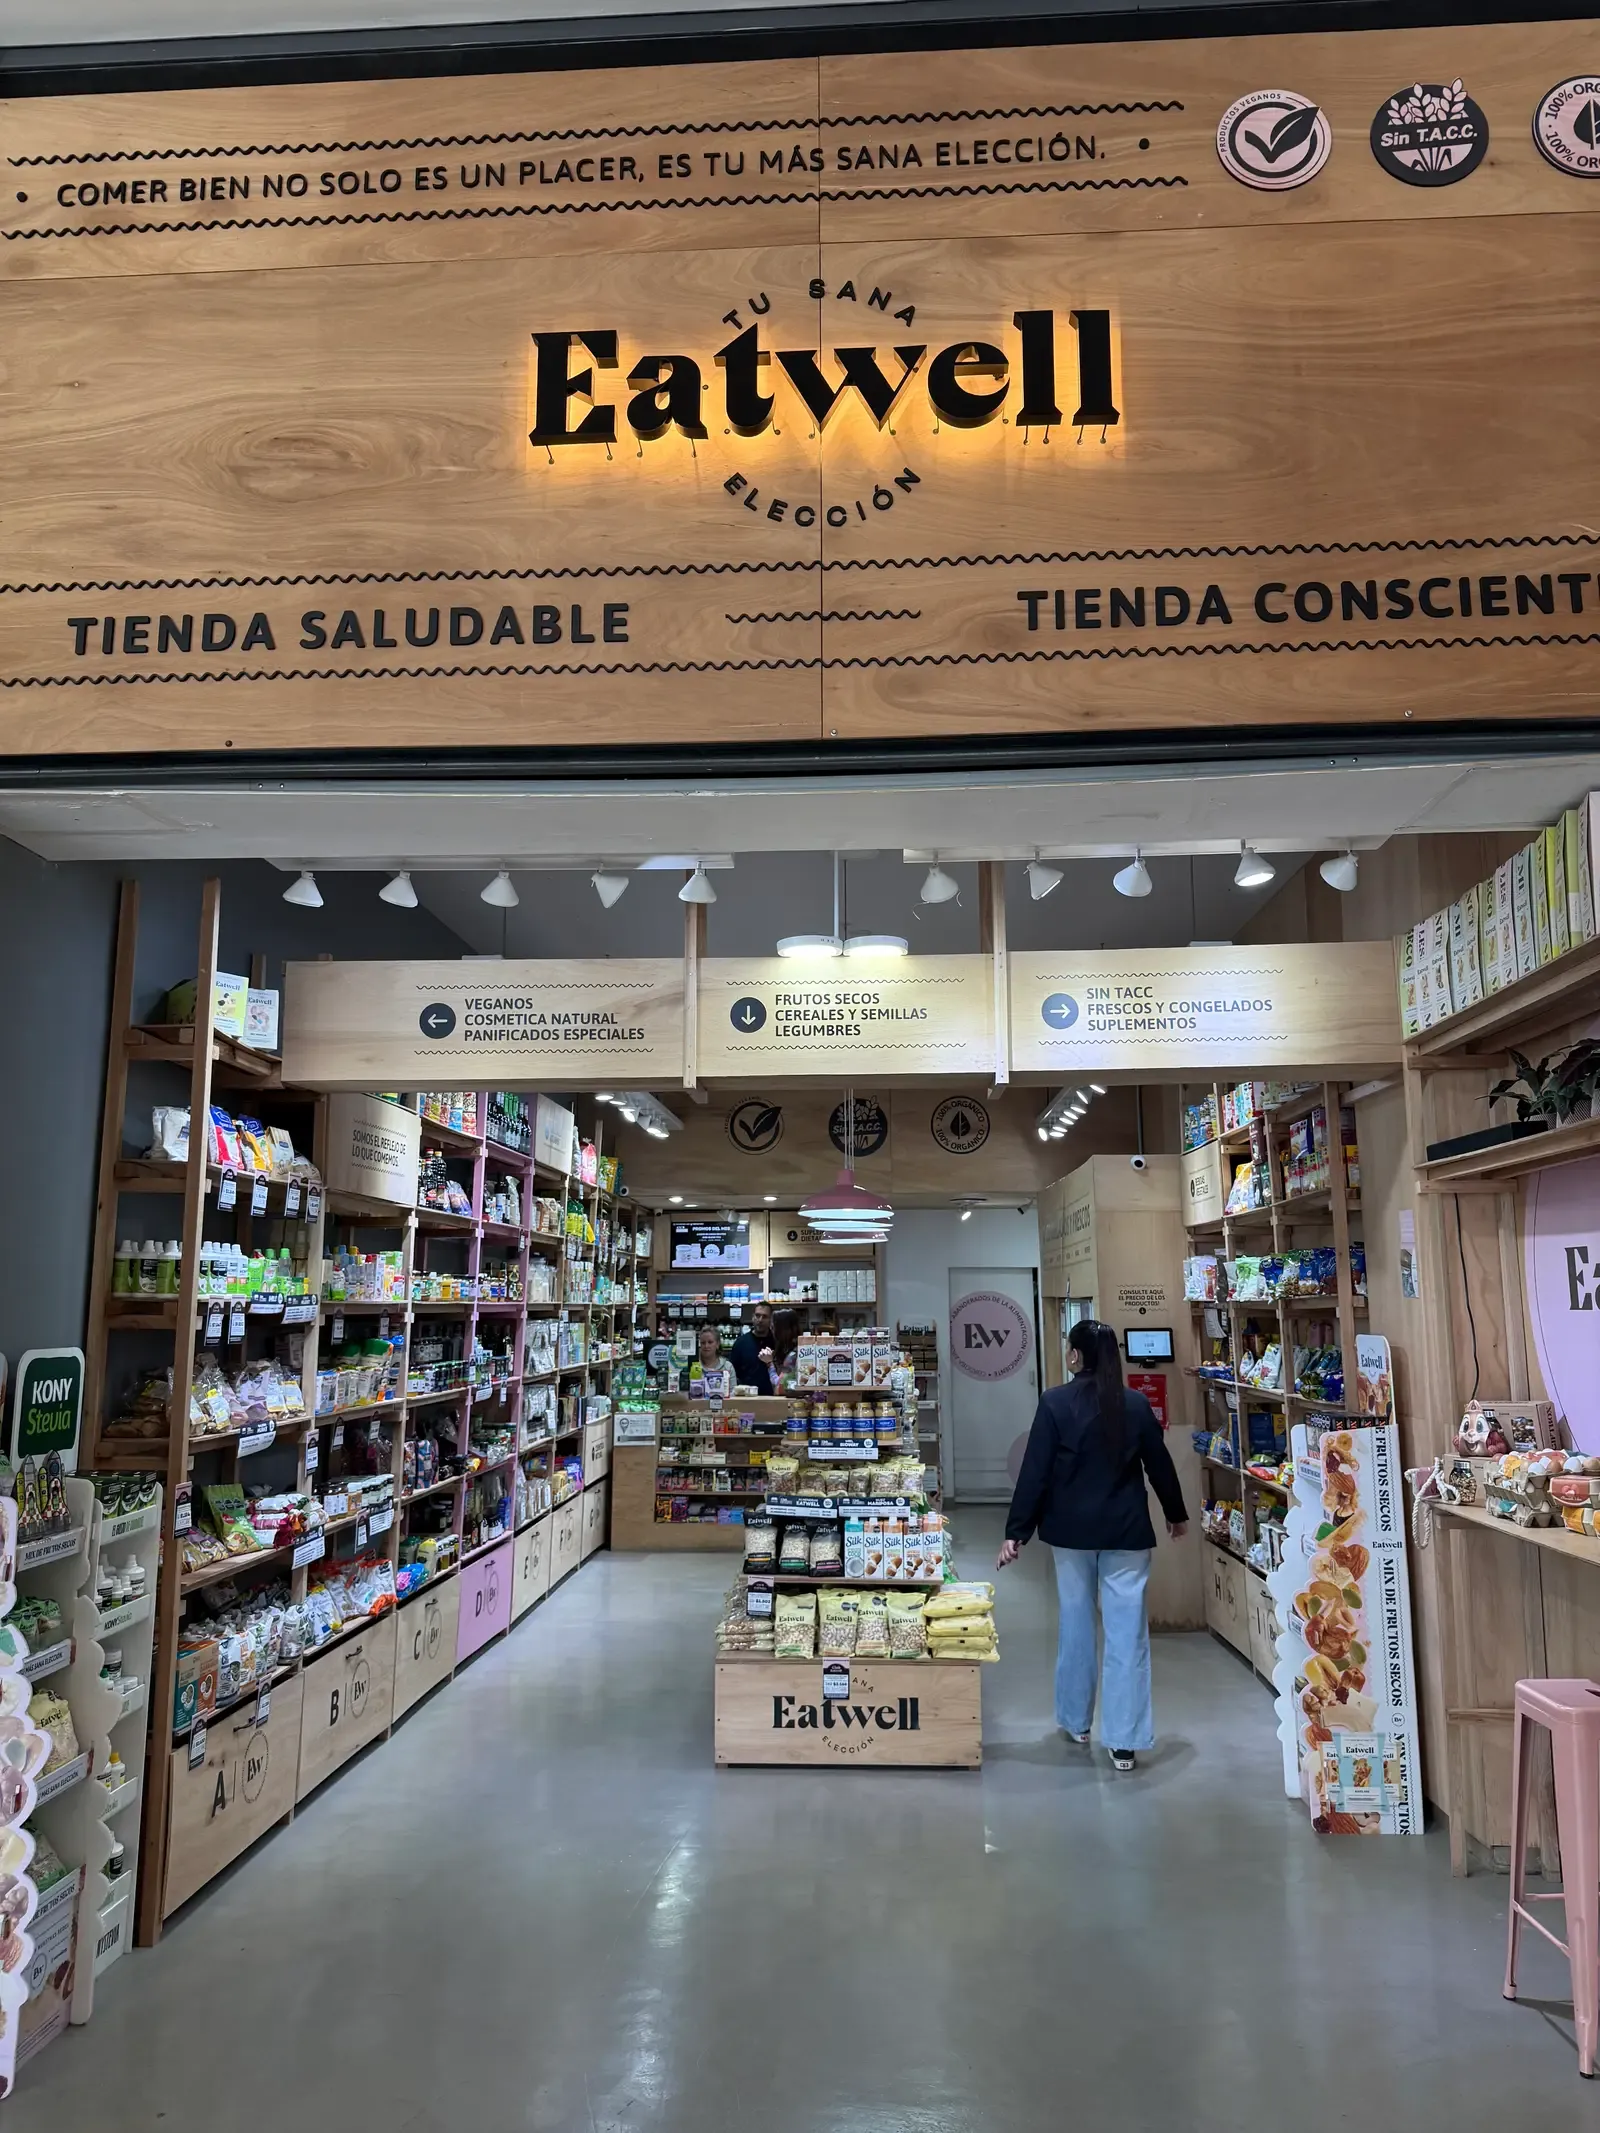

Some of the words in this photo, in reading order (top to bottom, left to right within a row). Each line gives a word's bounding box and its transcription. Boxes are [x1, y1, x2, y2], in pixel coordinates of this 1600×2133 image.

[1545, 89, 1573, 120] 100%
[1219, 106, 1240, 153] PRODUCTOS
[1240, 93, 1281, 107] VEGANOS
[1380, 131, 1410, 148] Sin
[1416, 123, 1478, 143] T.A.C.C.
[1546, 131, 1576, 163] 100%
[1577, 156, 1600, 168] OR
[57, 179, 168, 208] COMER
[180, 175, 250, 201] BIEN
[263, 173, 308, 198] NO
[319, 168, 402, 195] SOLO
[414, 166, 449, 191] ES
[460, 162, 506, 187] UN
[518, 155, 645, 186] PLACER,
[657, 153, 692, 178] ES
[704, 151, 744, 176] TU
[759, 144, 826, 173] MÁS
[837, 143, 923, 170] SANA
[935, 132, 1106, 166] ELECCIÓN.
[722, 292, 772, 331] TU
[809, 278, 917, 328] SANA
[529, 309, 1122, 448] Eatwell
[723, 466, 922, 528] ELECCIÓN
[1016, 583, 1233, 632] TIENDA
[1252, 572, 1600, 626] CONSCIENT
[67, 612, 277, 656] TIENDA
[298, 602, 631, 652] SALUDABLE
[216, 981, 241, 991] Eatwell
[1086, 987, 1110, 1000] SIN
[1114, 986, 1153, 999] TACC
[464, 998, 533, 1010] VEGANOS
[775, 993, 831, 1006] FRUTOS
[834, 992, 880, 1005] SECOS
[1087, 1003, 1152, 1016] FRESCOS
[1155, 1002, 1165, 1015] Y
[1169, 999, 1273, 1014] CONGELADOS
[464, 1013, 547, 1026] COSMETICA
[551, 1012, 618, 1025] NATURAL
[775, 1009, 844, 1022] CEREALES
[848, 1008, 857, 1020] Y
[860, 1008, 928, 1021] SEMILLAS
[775, 1024, 861, 1037] LEGUMBRES
[1087, 1017, 1197, 1031] SUPLEMENTOS
[464, 1028, 560, 1042] PANIFICADOS
[563, 1028, 645, 1041] ESPECIALES
[353, 1129, 374, 1146] SOMOS
[374, 1135, 381, 1147] EL
[381, 1137, 400, 1153] REFLEJO
[400, 1143, 406, 1155] DE
[352, 1144, 361, 1157] LO
[361, 1147, 373, 1160] QUE
[799, 1347, 815, 1358] Silk
[817, 1347, 829, 1358] Sil
[854, 1347, 870, 1358] Silk
[873, 1347, 890, 1358] Silk
[1360, 1354, 1383, 1369] Eatwell
[31, 1377, 73, 1405] KONY
[26, 1403, 72, 1436] Stevia
[1376, 1437, 1390, 1486] FRUTOS
[1378, 1489, 1392, 1532] SECOS
[748, 1517, 772, 1525] Eatwell
[846, 1537, 862, 1548] Silk
[864, 1537, 882, 1548] Silk
[884, 1537, 901, 1548] Silk
[904, 1538, 922, 1549] Silk
[924, 1534, 941, 1546] Silk
[1372, 1540, 1403, 1549] Eatwell
[1382, 1558, 1394, 1585] MIX
[1214, 1573, 1222, 1601] H
[475, 1590, 482, 1617] D
[1385, 1588, 1396, 1605] DE
[826, 1614, 853, 1622] Eatwell
[1386, 1608, 1400, 1659] FRUTOS
[413, 1629, 421, 1660] C
[852, 1677, 874, 1693] ANA
[1389, 1662, 1403, 1707] SECOS
[330, 1687, 339, 1726] B
[772, 1695, 921, 1731] Eatwell
[821, 1735, 875, 1754] ELECCIÓN
[1345, 1746, 1375, 1754] Eatwell
[211, 1769, 227, 1819] A
